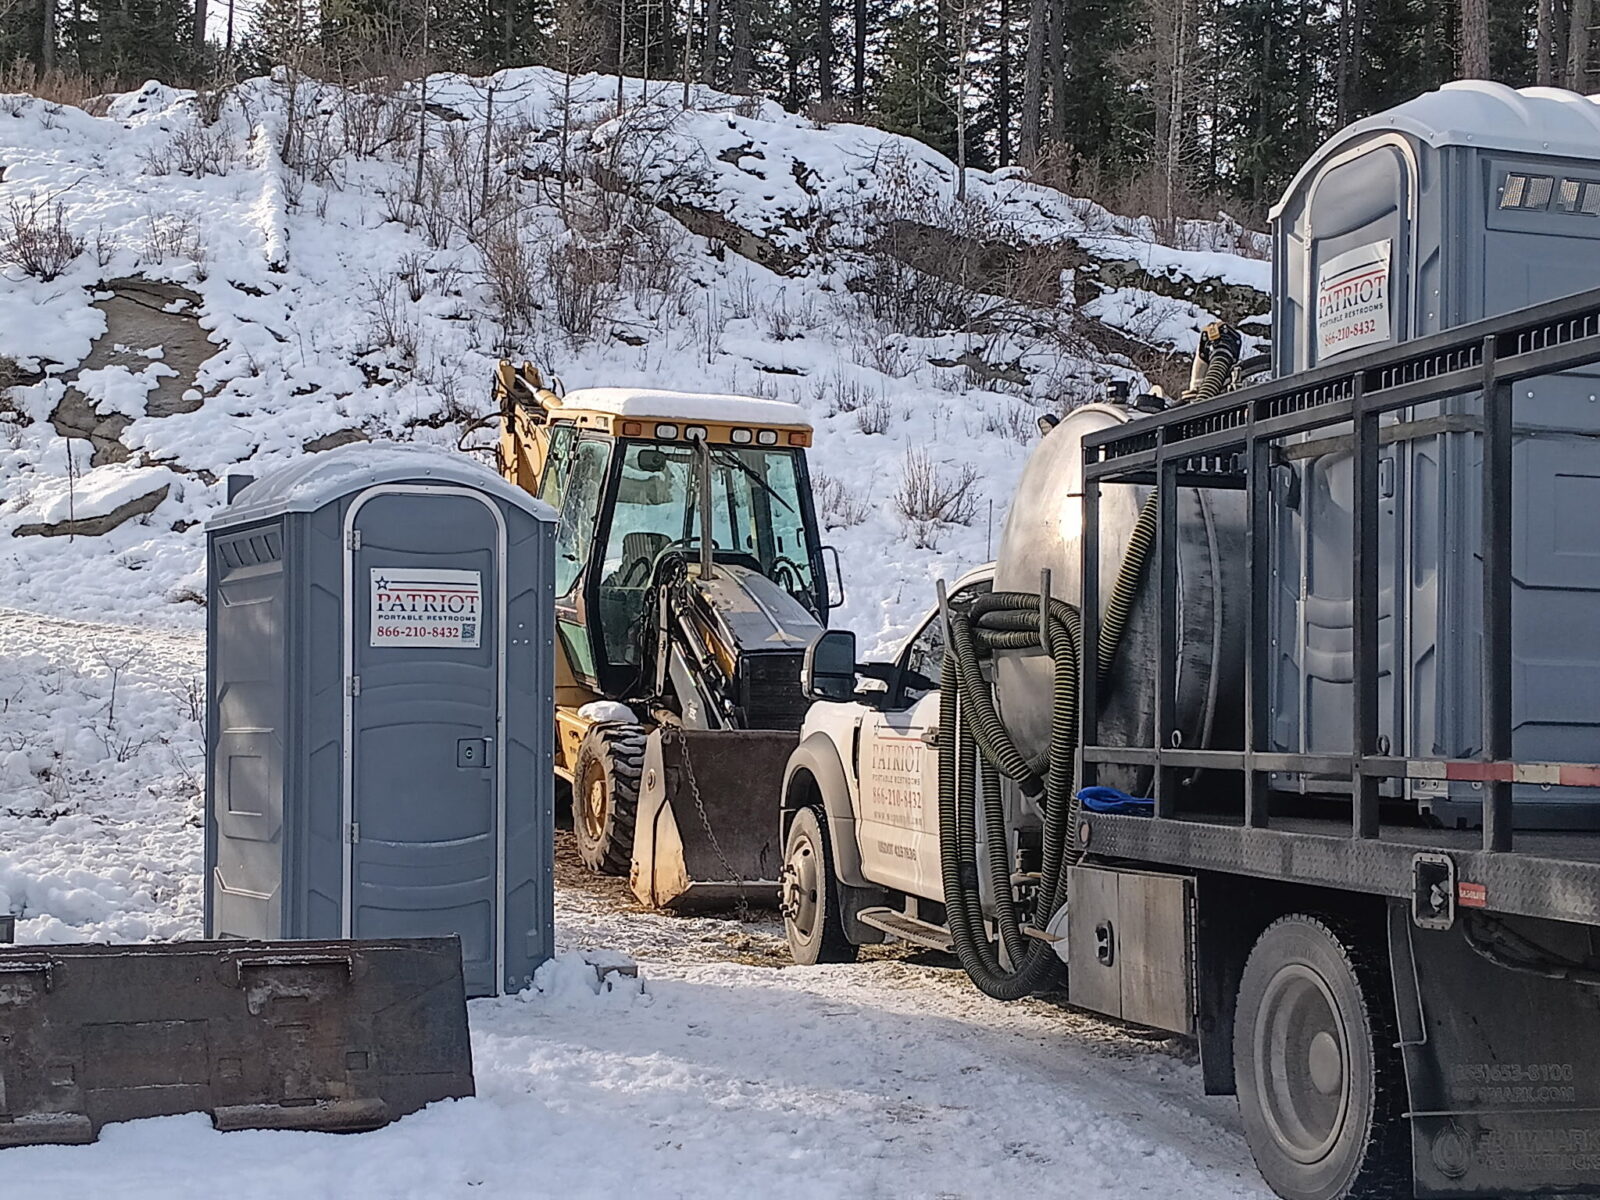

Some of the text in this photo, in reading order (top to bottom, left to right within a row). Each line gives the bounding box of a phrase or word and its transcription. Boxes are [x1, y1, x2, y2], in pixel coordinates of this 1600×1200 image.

[1318, 275, 1386, 319] PATRIOT
[1344, 303, 1384, 319] RESTROOMS
[1324, 319, 1376, 347] 866-210-8432
[376, 593, 479, 613] PATRIOT
[377, 626, 459, 638] 866-210-8432
[872, 744, 922, 773] PATRIOT
[873, 787, 922, 809] 866-210-8432
